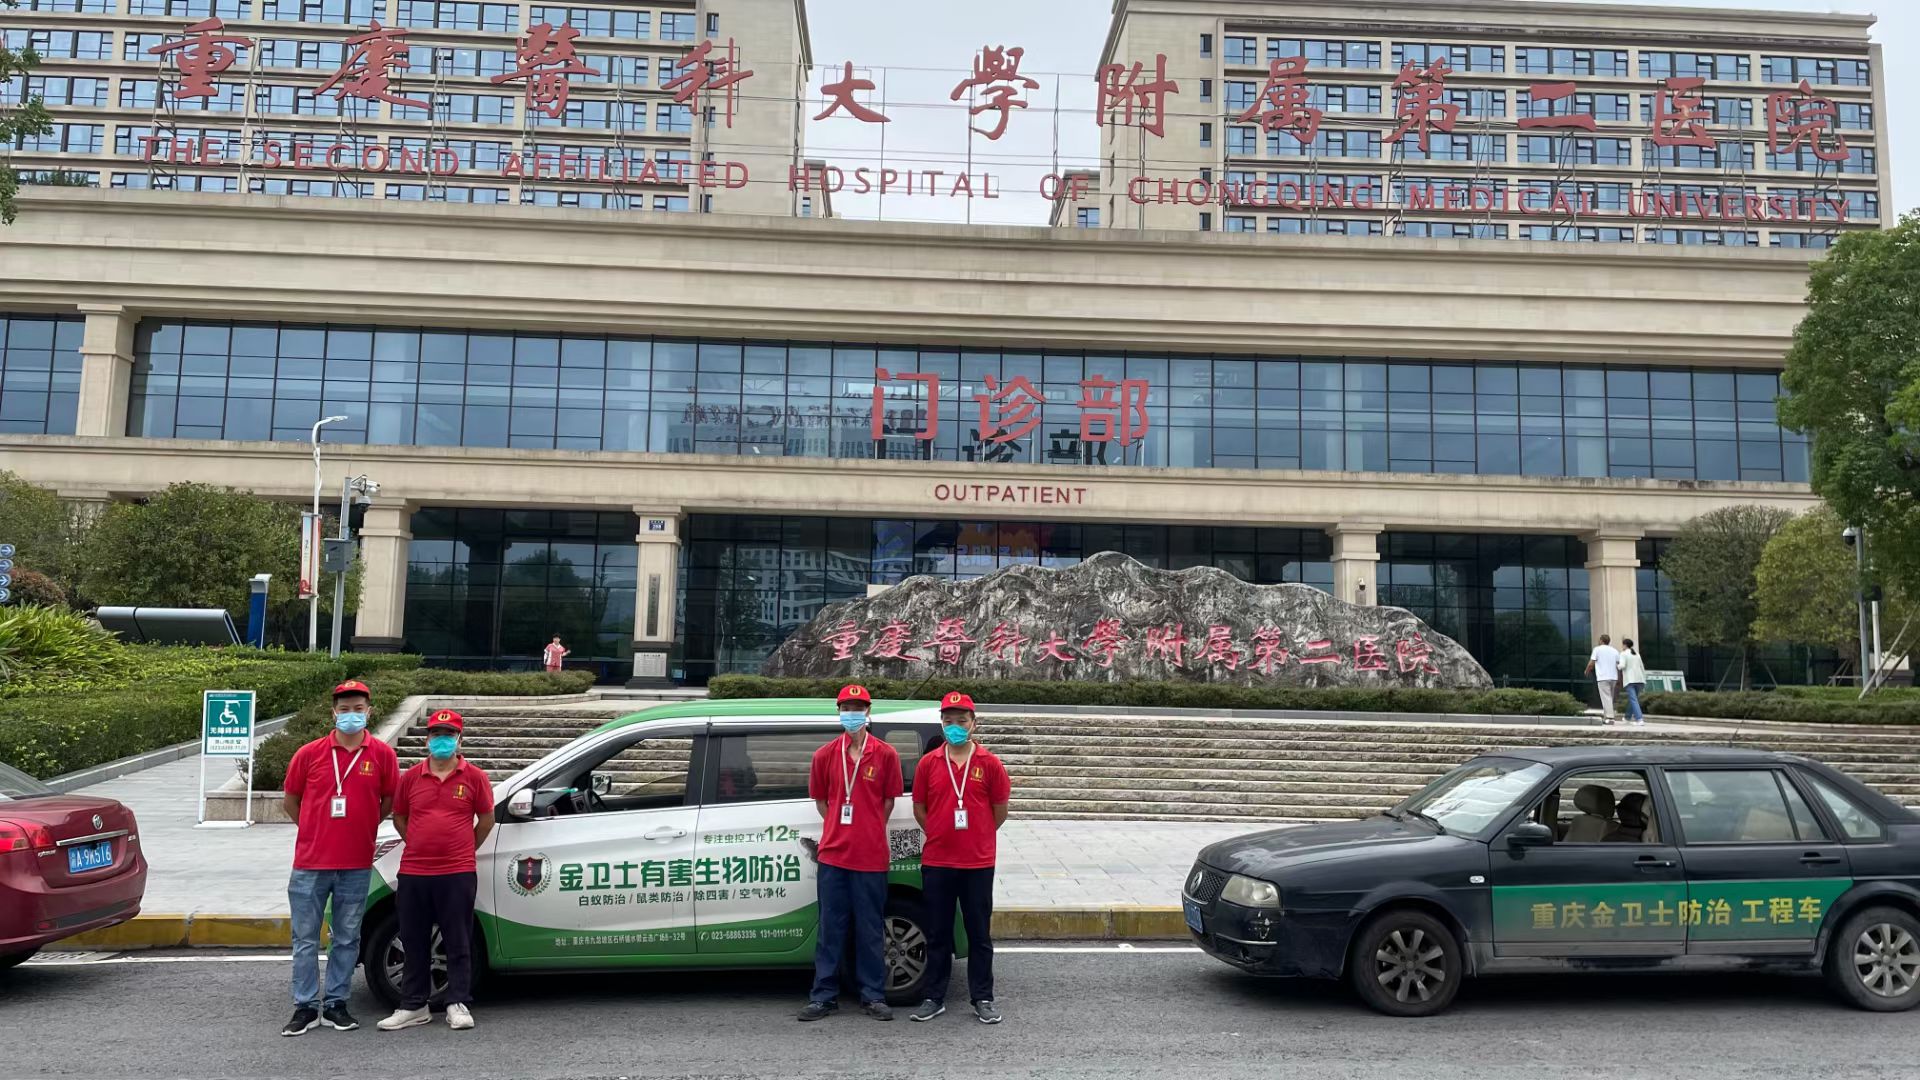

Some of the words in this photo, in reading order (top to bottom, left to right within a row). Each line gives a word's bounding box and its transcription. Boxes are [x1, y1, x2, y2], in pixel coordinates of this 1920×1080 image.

[138, 136, 224, 165] THE
[262, 141, 459, 175] SECOND
[502, 153, 749, 188] AFFILIATED
[788, 165, 1000, 199] HOSPITAL
[1040, 174, 1089, 201] OF
[1129, 177, 1374, 210] CHONGQING
[1408, 185, 1598, 215] MEDICAL
[1629, 191, 1850, 222] UNIVERSITY
[872, 367, 1149, 446] 门诊部
[934, 484, 1087, 504] OUTPATIENT
[703, 825, 800, 845] 专注虫控工作12年
[559, 853, 801, 891] 金卫士有害生物防治
[1530, 898, 1733, 930] 重庆金卫士防治
[1741, 896, 1822, 925] 工程车
